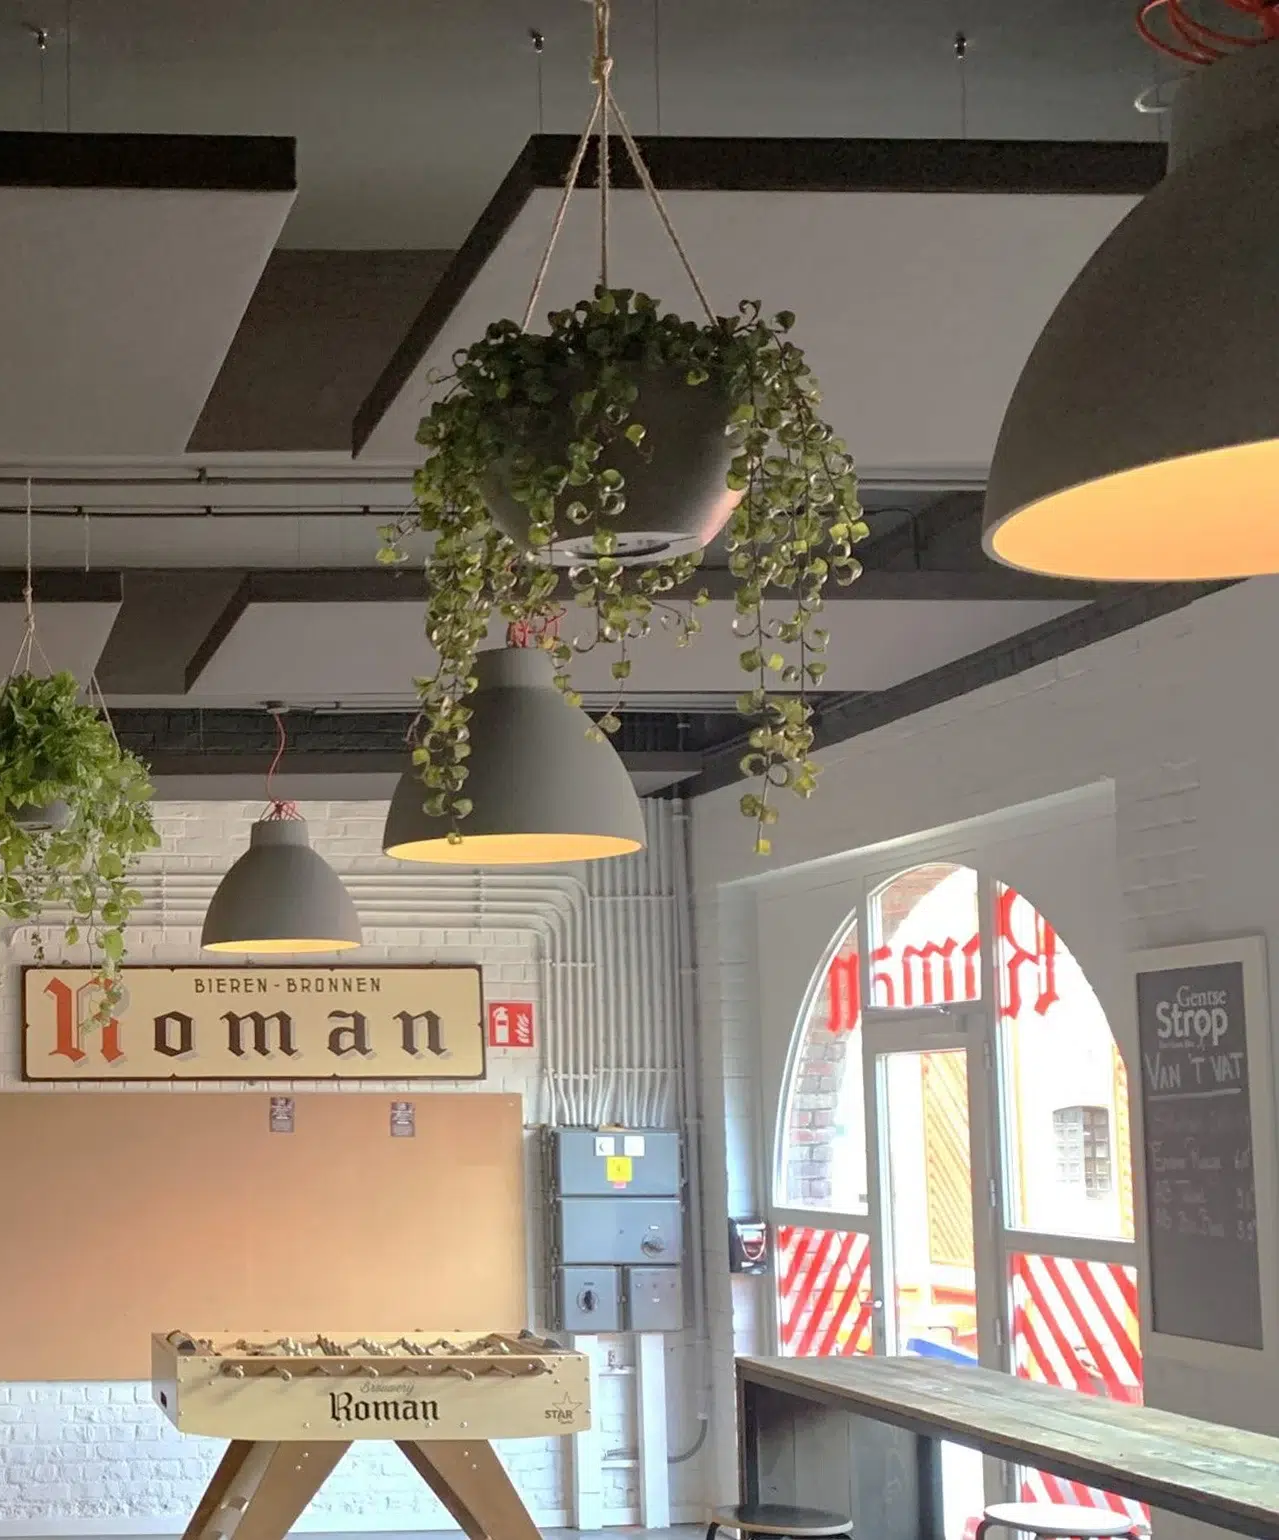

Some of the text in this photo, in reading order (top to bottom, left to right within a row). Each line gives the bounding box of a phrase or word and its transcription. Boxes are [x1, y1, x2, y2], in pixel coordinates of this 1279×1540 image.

[42, 976, 448, 1063] Roman
[1156, 1001, 1228, 1046] Strop
[1144, 1052, 1181, 1090] VAN
[1210, 1052, 1244, 1083] VAT
[329, 1391, 440, 1422] Roman
[544, 1409, 573, 1420] STAR
